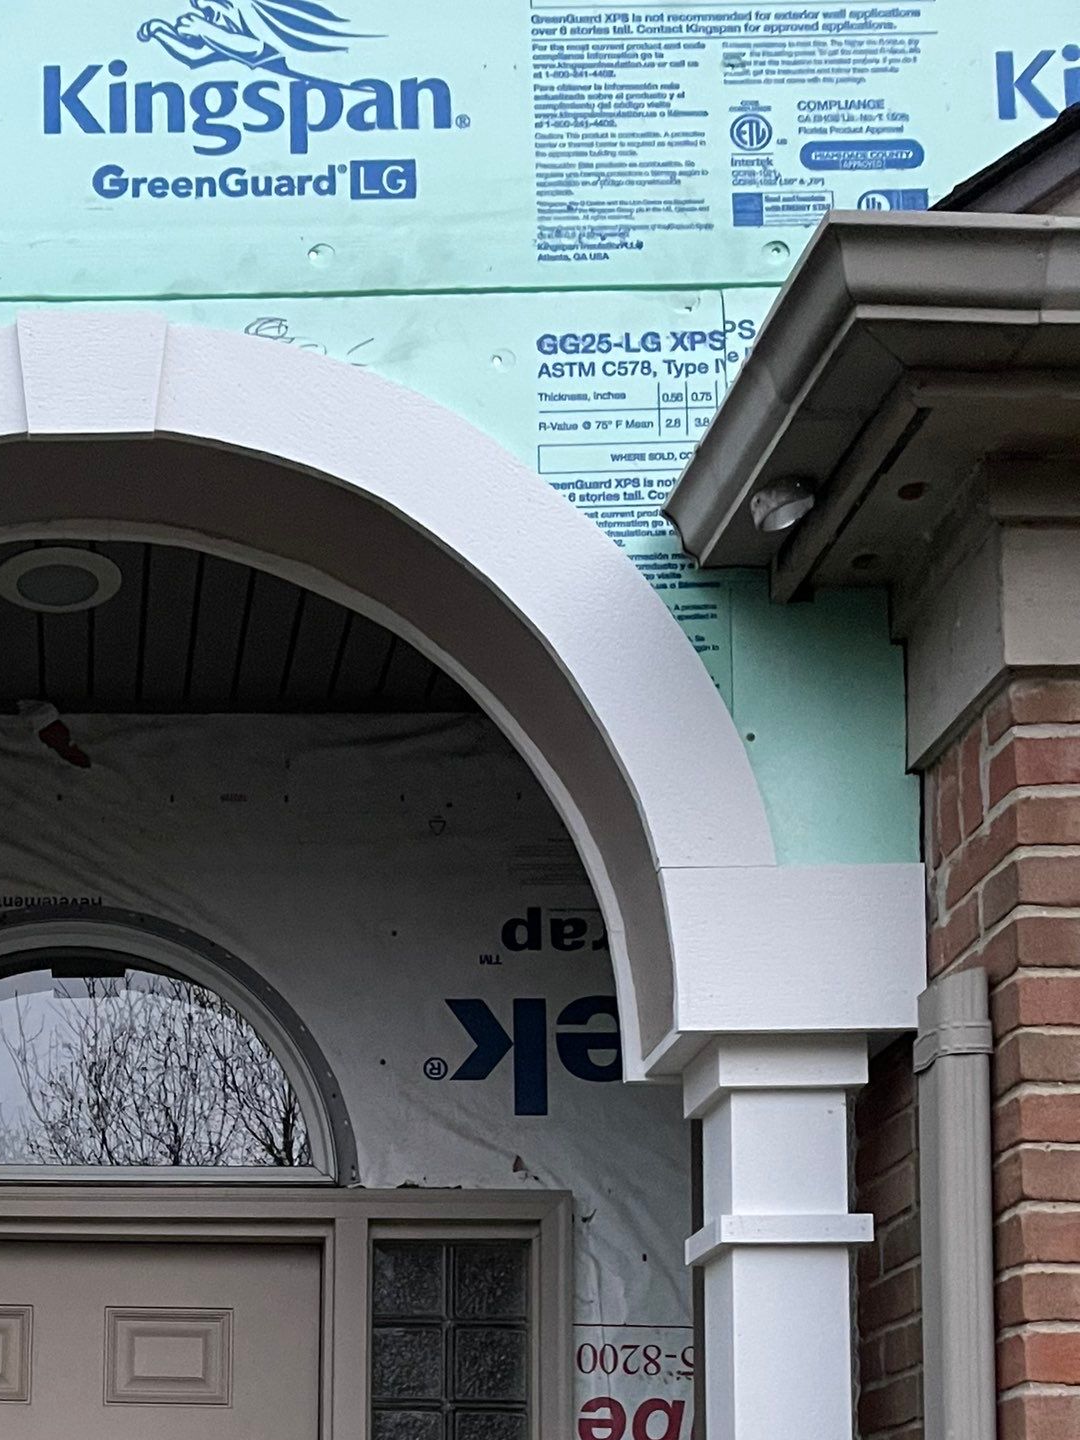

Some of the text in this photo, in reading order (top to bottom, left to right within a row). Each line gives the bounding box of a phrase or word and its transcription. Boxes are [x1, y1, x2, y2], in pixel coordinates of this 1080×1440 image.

[531, 9, 920, 24] GreenGuard XPS is not recommended for exterior wall applications
[531, 27, 557, 36] over
[570, 25, 609, 34] stories
[636, 24, 683, 33] Contact
[686, 23, 741, 35] Kingspan
[744, 23, 760, 32] for
[764, 22, 819, 34] approved
[822, 21, 897, 32] applications.
[797, 99, 885, 111] COMPLIANCE
[731, 157, 773, 167] Intertek
[356, 163, 410, 196] LG
[537, 332, 661, 355] GG25-LG
[670, 330, 726, 351] XPS
[538, 362, 595, 378] ASTM
[602, 361, 657, 378] C578,
[663, 359, 709, 378] Type
[538, 392, 590, 401] Thickness,
[692, 392, 712, 401] 0.75
[539, 422, 578, 431] R-Value
[583, 422, 591, 430] @
[616, 421, 622, 429] F
[626, 420, 653, 429] Mean
[666, 419, 681, 428] 2.8
[611, 453, 645, 462] WHERE
[649, 453, 677, 461] SOLD,
[615, 478, 640, 488] XPS
[644, 478, 653, 487] is
[569, 493, 575, 502] 6
[579, 492, 620, 502] stories
[623, 491, 644, 501] tall.
